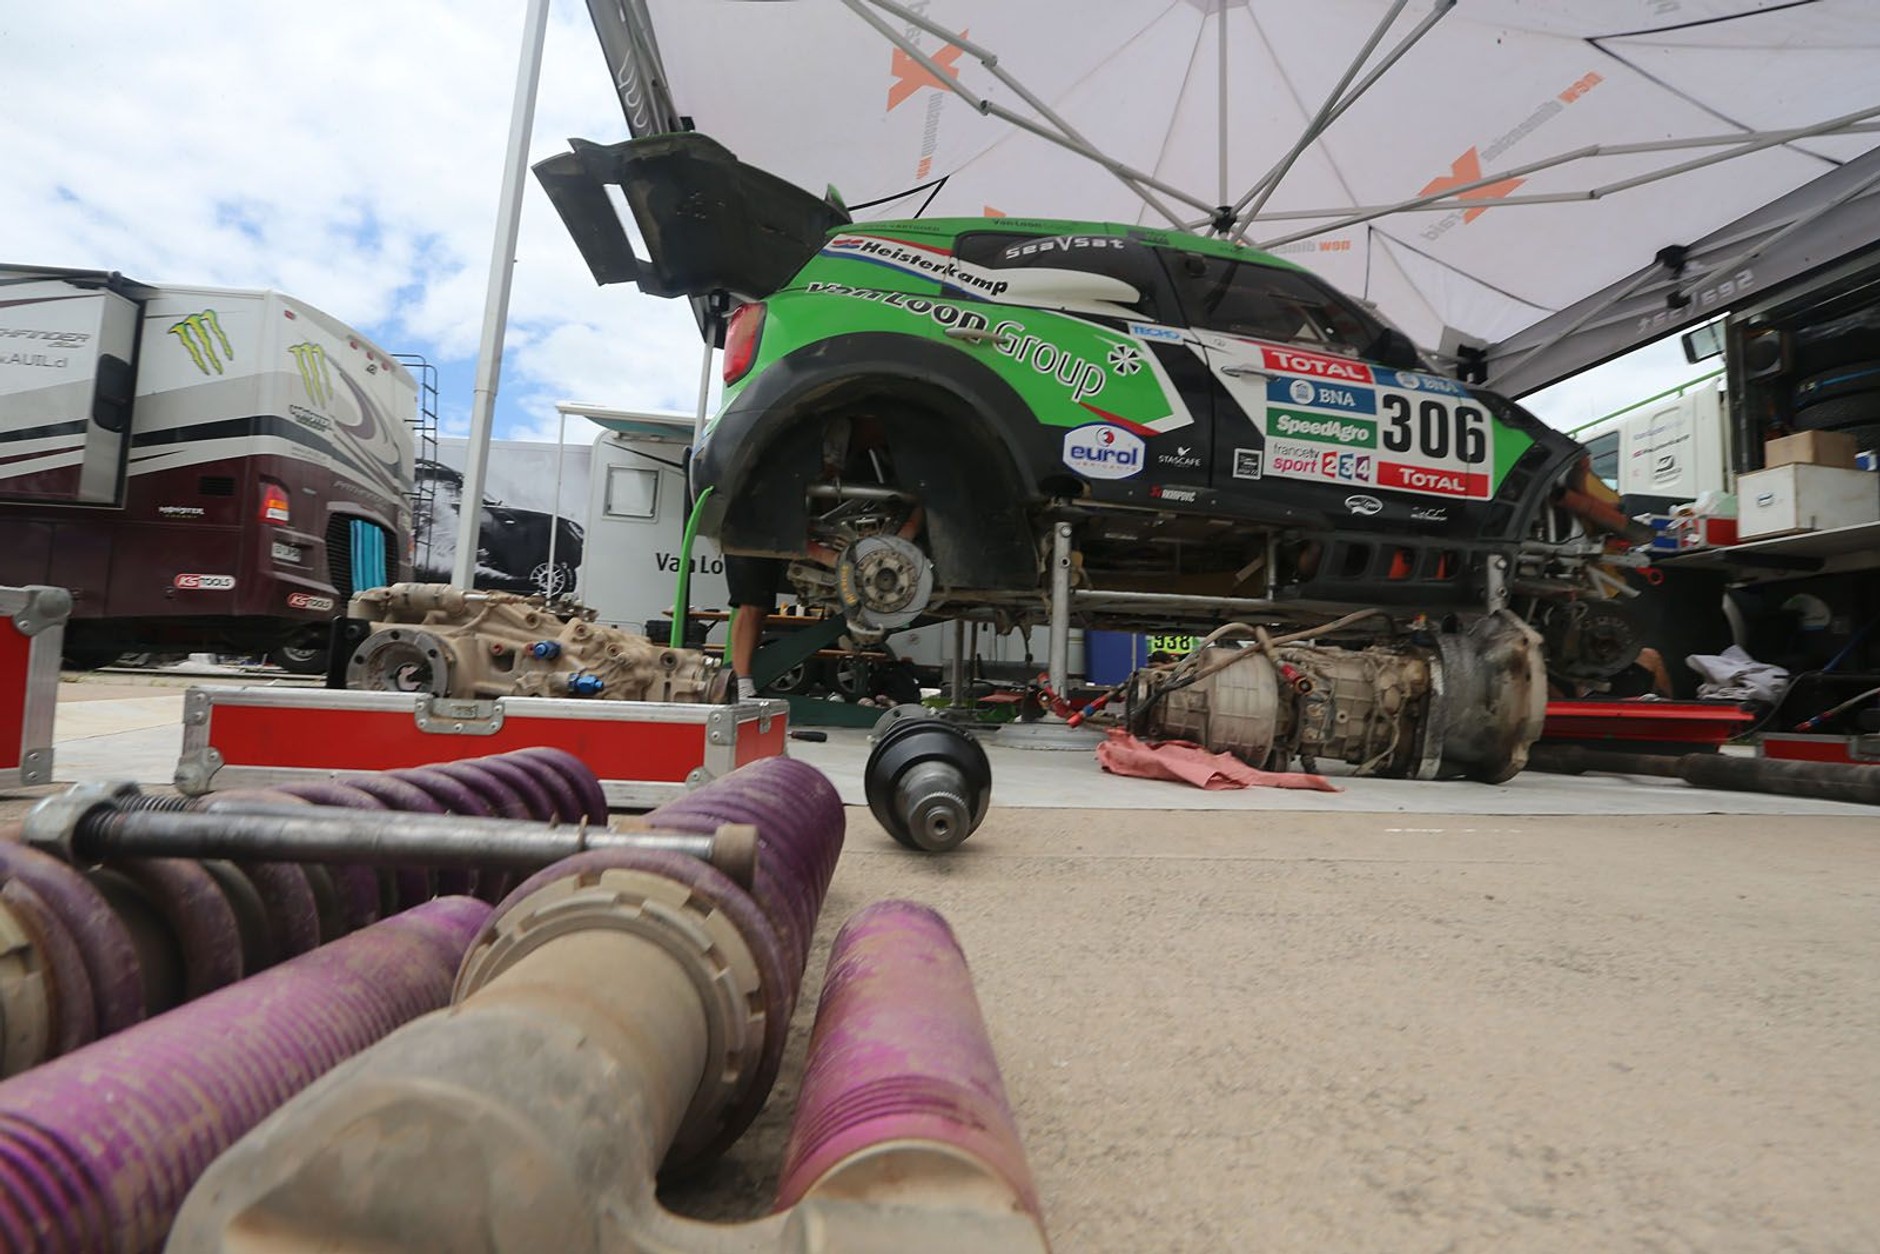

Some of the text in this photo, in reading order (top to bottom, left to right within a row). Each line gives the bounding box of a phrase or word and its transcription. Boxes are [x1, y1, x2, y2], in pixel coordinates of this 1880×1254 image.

[861, 241, 1008, 296] Heisterkamp
[807, 281, 1107, 404] Van Loon Group
[1271, 351, 1364, 379] TOTAL
[1319, 388, 1356, 407] BNA
[1276, 413, 1370, 442] SpeedAgro
[1382, 393, 1487, 464] 306
[1071, 447, 1138, 467] eurol
[1273, 456, 1318, 473] sport
[1399, 467, 1466, 491] TOTAL
[199, 576, 232, 587] TOOLS
